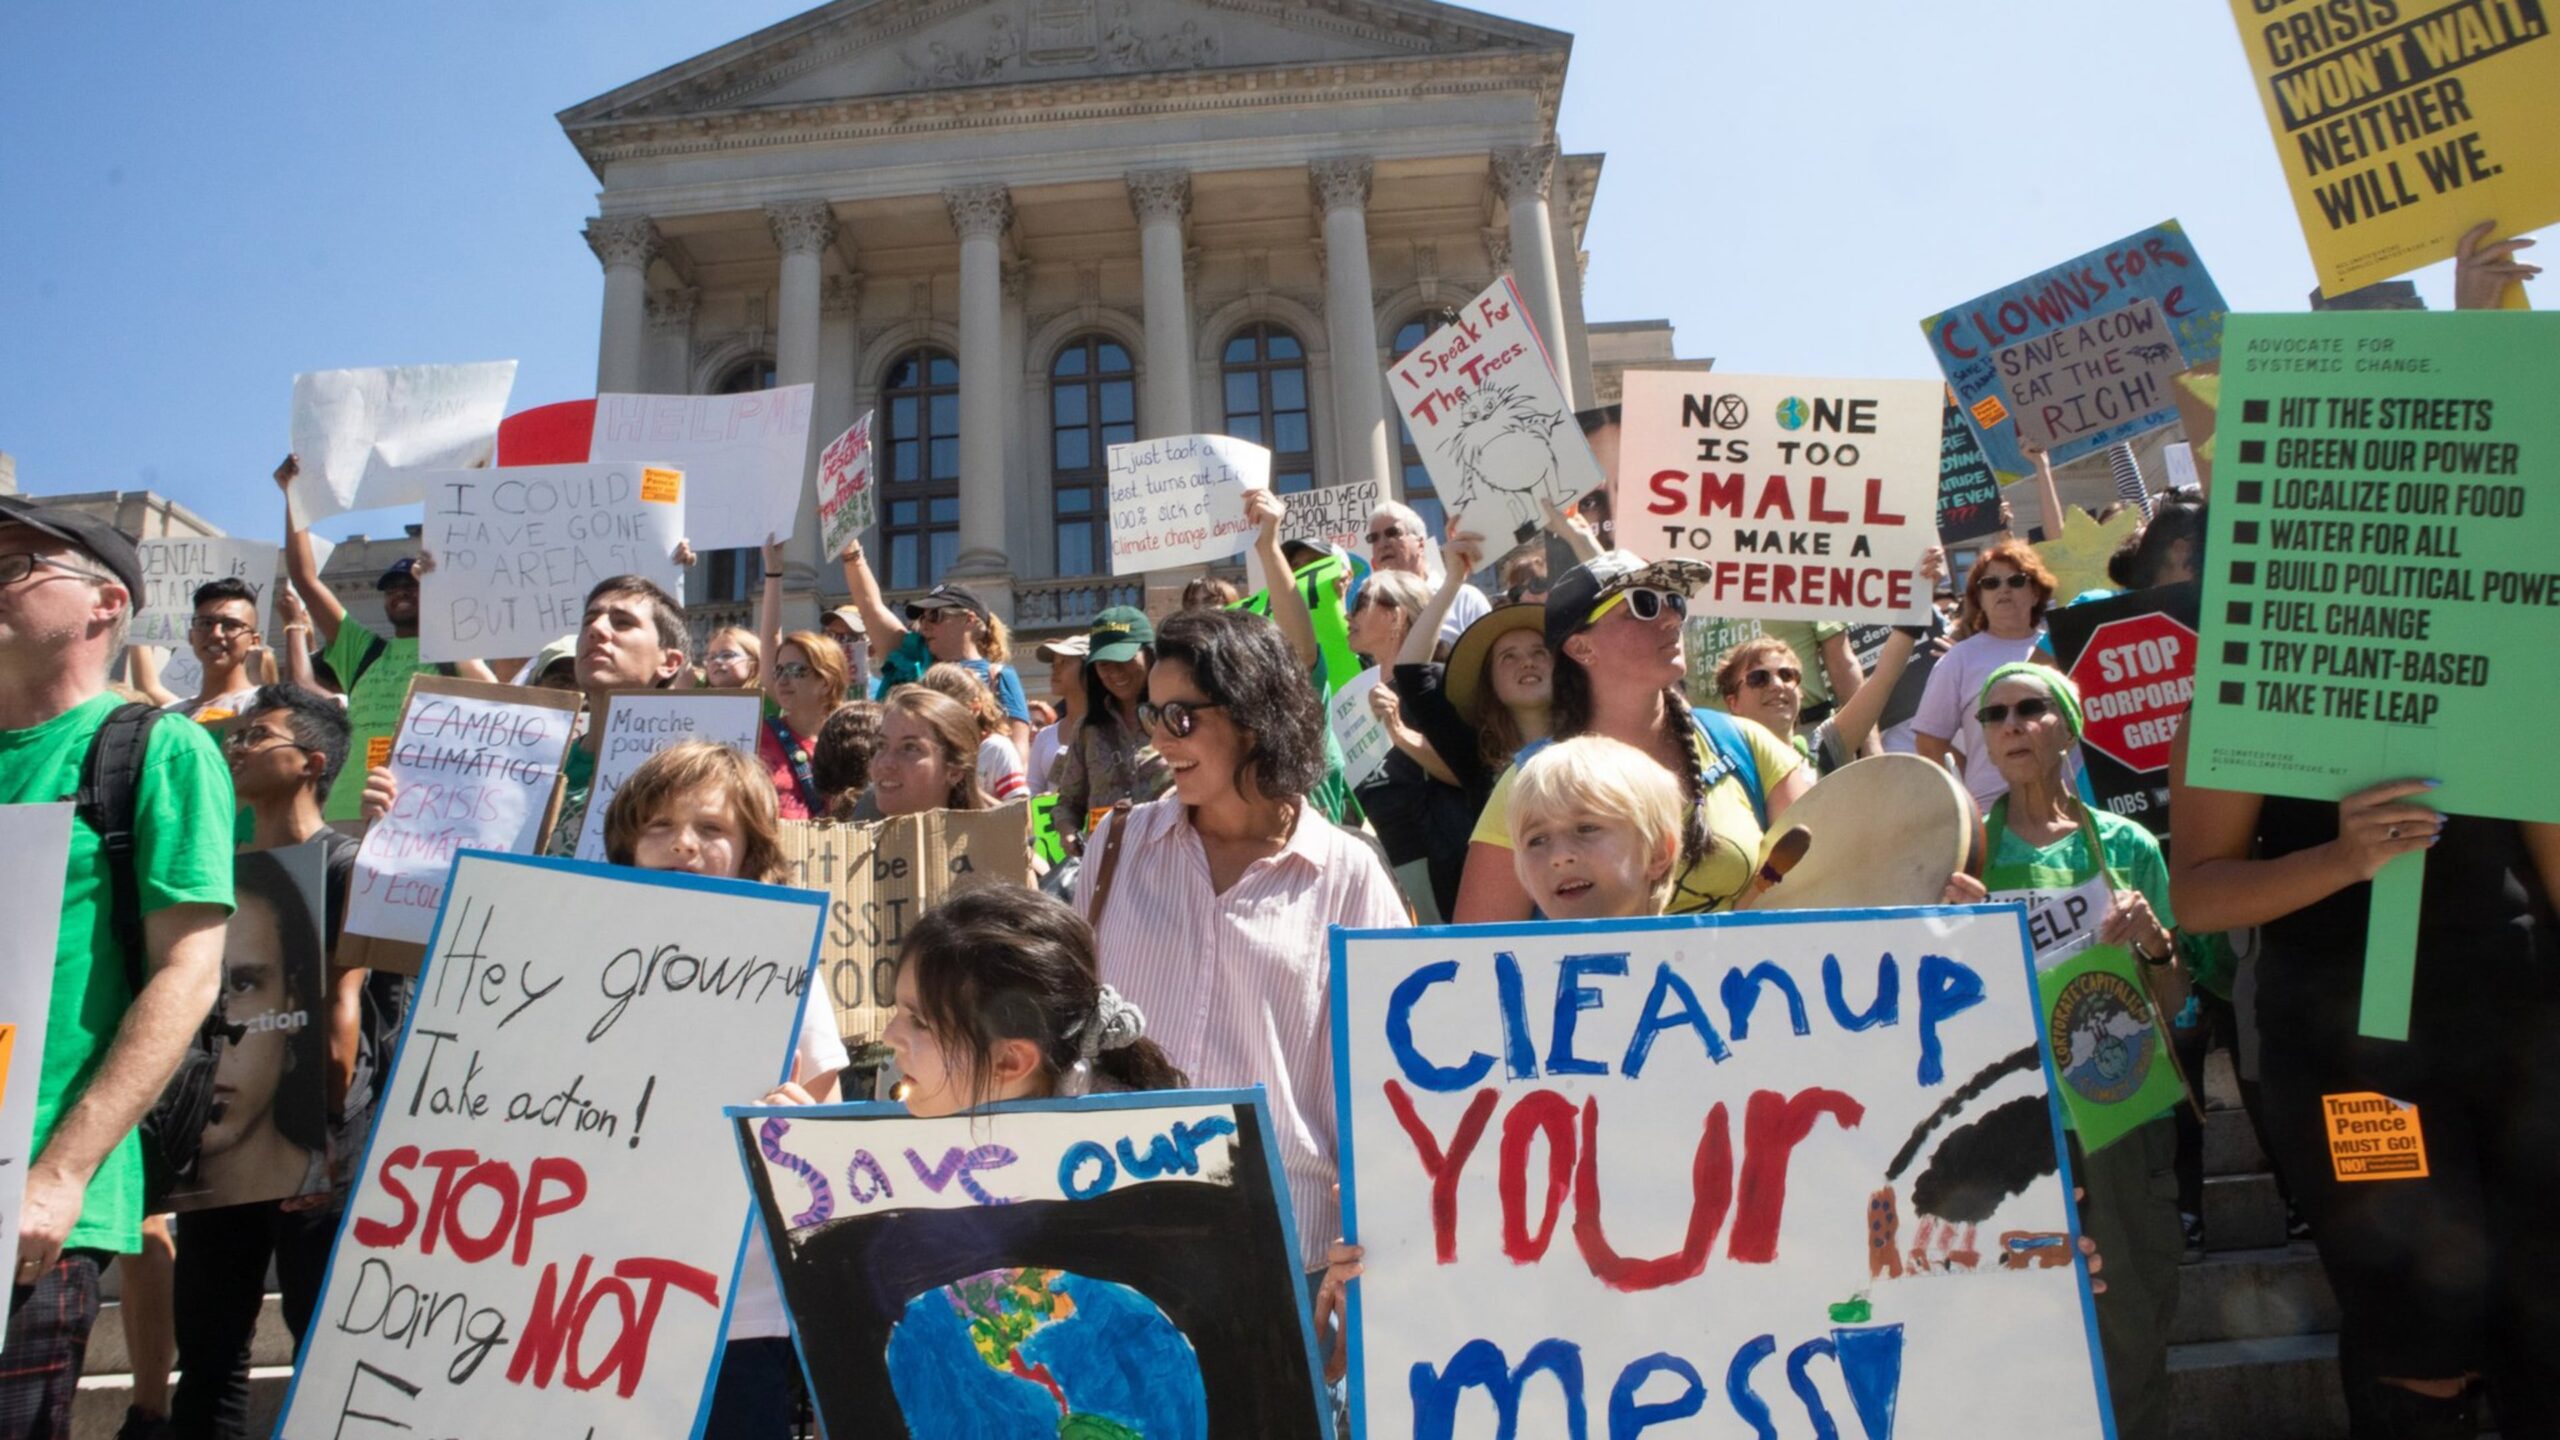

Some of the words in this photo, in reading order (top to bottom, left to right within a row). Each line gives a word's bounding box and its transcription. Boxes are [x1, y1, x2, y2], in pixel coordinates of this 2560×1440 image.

[2263, 0, 2400, 68] CRISIS
[2276, 32, 2411, 123] WON'T
[2297, 77, 2473, 177] NEITHER
[2313, 161, 2420, 231] WILL
[2416, 131, 2504, 195] WE.
[1941, 265, 2109, 360] CLOWNS
[2104, 237, 2190, 289] FOR
[1400, 369, 1420, 390] I
[1418, 319, 1482, 380] Speak
[1478, 297, 1511, 328] For
[1457, 341, 1528, 387] Trees.
[2000, 327, 2071, 377] SAVE
[2078, 325, 2098, 353] A
[2098, 306, 2155, 343] COW
[2246, 337, 2344, 354] ADVOCATE
[2357, 338, 2396, 353] FOR
[2011, 370, 2054, 406] EAT
[2062, 348, 2124, 387] THE
[2245, 358, 2344, 374] SYSTEMIC
[2355, 358, 2443, 375] CHANGE.
[606, 395, 763, 442] HELP
[2041, 372, 2160, 440] RICH!
[2278, 396, 2318, 429] HIT
[2326, 397, 2374, 430] THE
[2378, 398, 2495, 432] STREETS
[1110, 446, 1129, 473] I
[1127, 450, 1162, 475] just
[1165, 437, 1200, 462] took
[1202, 444, 1217, 458] a
[1696, 438, 1750, 464] IS
[1776, 441, 1861, 467] TOO
[2275, 437, 2357, 471] GREEN
[2362, 440, 2417, 472] OUR
[2422, 441, 2521, 475] POWER
[438, 483, 477, 516] I
[491, 471, 631, 515] COULD
[1284, 488, 1333, 510] SHOULD
[1646, 468, 1906, 527] SMALL
[1952, 484, 1996, 509] EVEN
[2271, 477, 2390, 514] LOCALIZE
[2395, 481, 2450, 515] OUR
[2454, 484, 2526, 518] FOOD
[445, 521, 548, 548] HAVE
[566, 510, 649, 543] GONE
[1112, 506, 1149, 531] 100%
[2269, 519, 2354, 554] WATER
[2360, 521, 2412, 557] FOR
[2414, 524, 2462, 558] ALL
[1661, 525, 1712, 551] TO
[1734, 529, 1832, 556] MAKE
[1849, 534, 1872, 559] A
[231, 557, 246, 576] is
[442, 548, 478, 572] TO
[488, 544, 602, 589] AREA
[1707, 560, 1914, 610] FERENCE
[2265, 560, 2339, 595] BUILD
[2343, 563, 2475, 603] POLITICAL
[450, 595, 516, 643] BUT
[2260, 600, 2319, 634] FUEL
[2325, 602, 2432, 641] CHANGE
[2097, 634, 2181, 684] STOP
[2258, 640, 2308, 674] TRY
[2312, 642, 2490, 689] PLANT-BASED
[611, 708, 695, 733] Marche
[2083, 674, 2196, 723] CORPORA
[2256, 680, 2317, 717] TAKE
[2322, 685, 2369, 720] THE
[2372, 688, 2440, 726] LEAP
[411, 700, 547, 748] CAMBIO
[2123, 710, 2184, 750] GREE
[391, 782, 505, 822] CRISIS
[873, 849, 910, 882] be
[950, 853, 976, 876] a
[436, 896, 566, 1031] Hey
[409, 1026, 490, 1118] Take
[503, 1074, 657, 1150] action!
[2332, 1138, 2382, 1154] MUST
[2386, 1135, 2418, 1151] GO!
[2335, 1116, 2407, 1136] Pence
[759, 1113, 1024, 1231] Save
[1056, 1113, 1239, 1203] our
[2340, 1157, 2368, 1174] NO!
[352, 1144, 589, 1268] STOP
[336, 1257, 510, 1387] Doing
[505, 1253, 721, 1401] NOT
